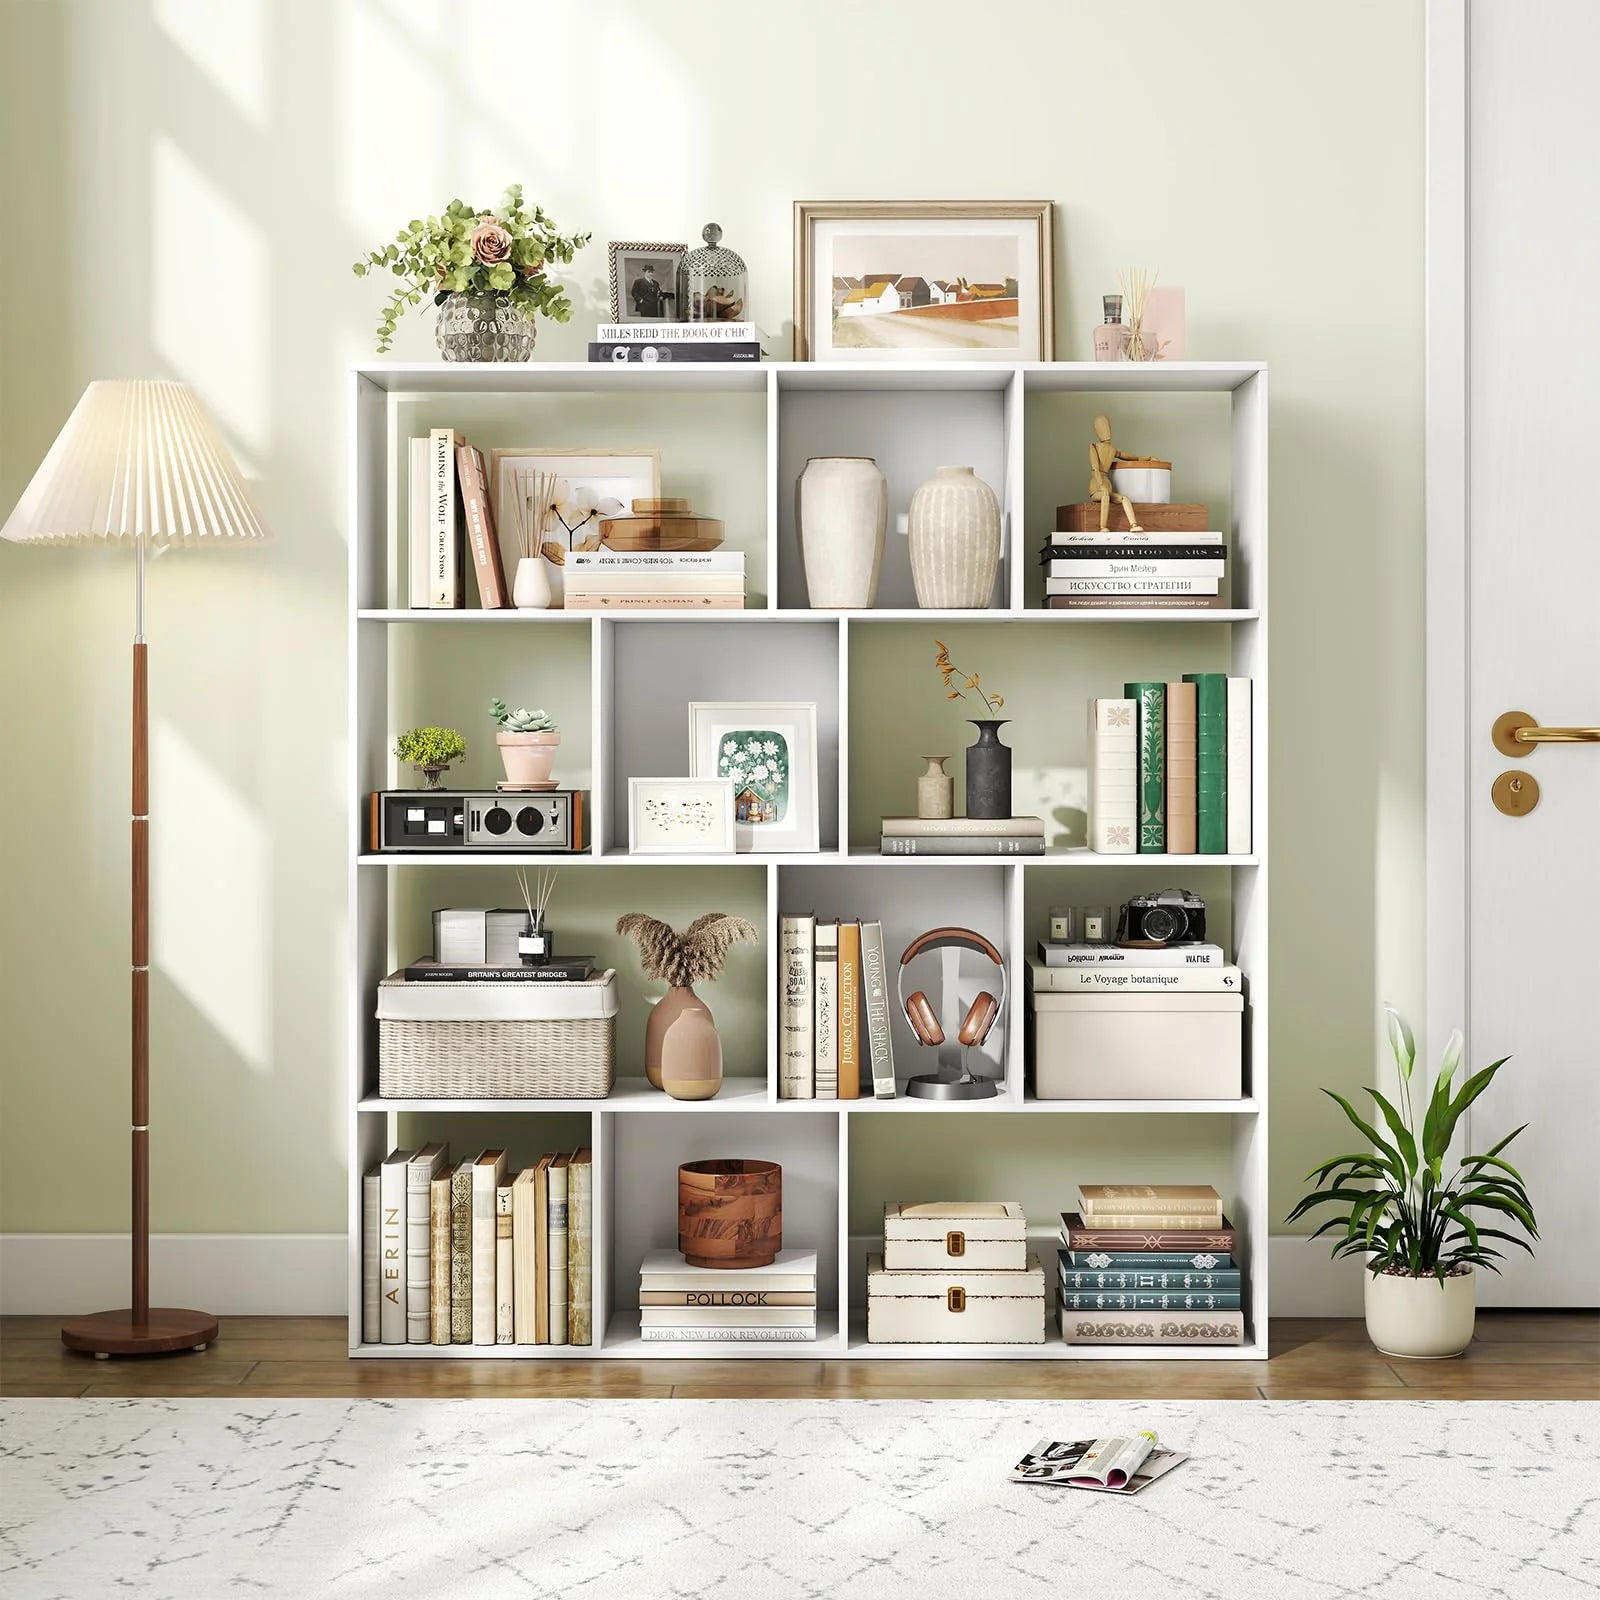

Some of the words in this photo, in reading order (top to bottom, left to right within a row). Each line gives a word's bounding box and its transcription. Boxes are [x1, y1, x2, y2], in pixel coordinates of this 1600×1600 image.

[602, 328, 631, 340] MILES
[633, 328, 659, 339] REDD
[660, 328, 680, 339] THE
[682, 327, 709, 339] BOOK
[710, 327, 724, 338] OF
[725, 327, 749, 338] CHIC
[438, 434, 448, 478] TAMING
[438, 480, 446, 493] the
[438, 493, 448, 525] WOLF
[478, 549, 487, 566] CATS
[1109, 564, 1129, 574] Эрин
[1130, 563, 1157, 574] Мейер
[1069, 581, 1131, 590] ИСКУССТВО
[1133, 581, 1192, 590] СТРАТЕГИИ
[866, 945, 882, 988] YOUNG
[1080, 974, 1092, 983] Le
[1094, 974, 1128, 985] Voyage
[1130, 974, 1179, 985] botanique
[841, 962, 852, 1026] COLLECTION
[871, 999, 885, 1022] THE
[842, 1029, 855, 1065] JUMBO
[872, 1026, 889, 1064] SHACK
[384, 1208, 400, 1305] AERIN
[686, 1293, 768, 1305] POLLOCK
[680, 1330, 705, 1339] NEW
[707, 1330, 737, 1339] LOOK
[739, 1330, 808, 1339] REVOLUTION
